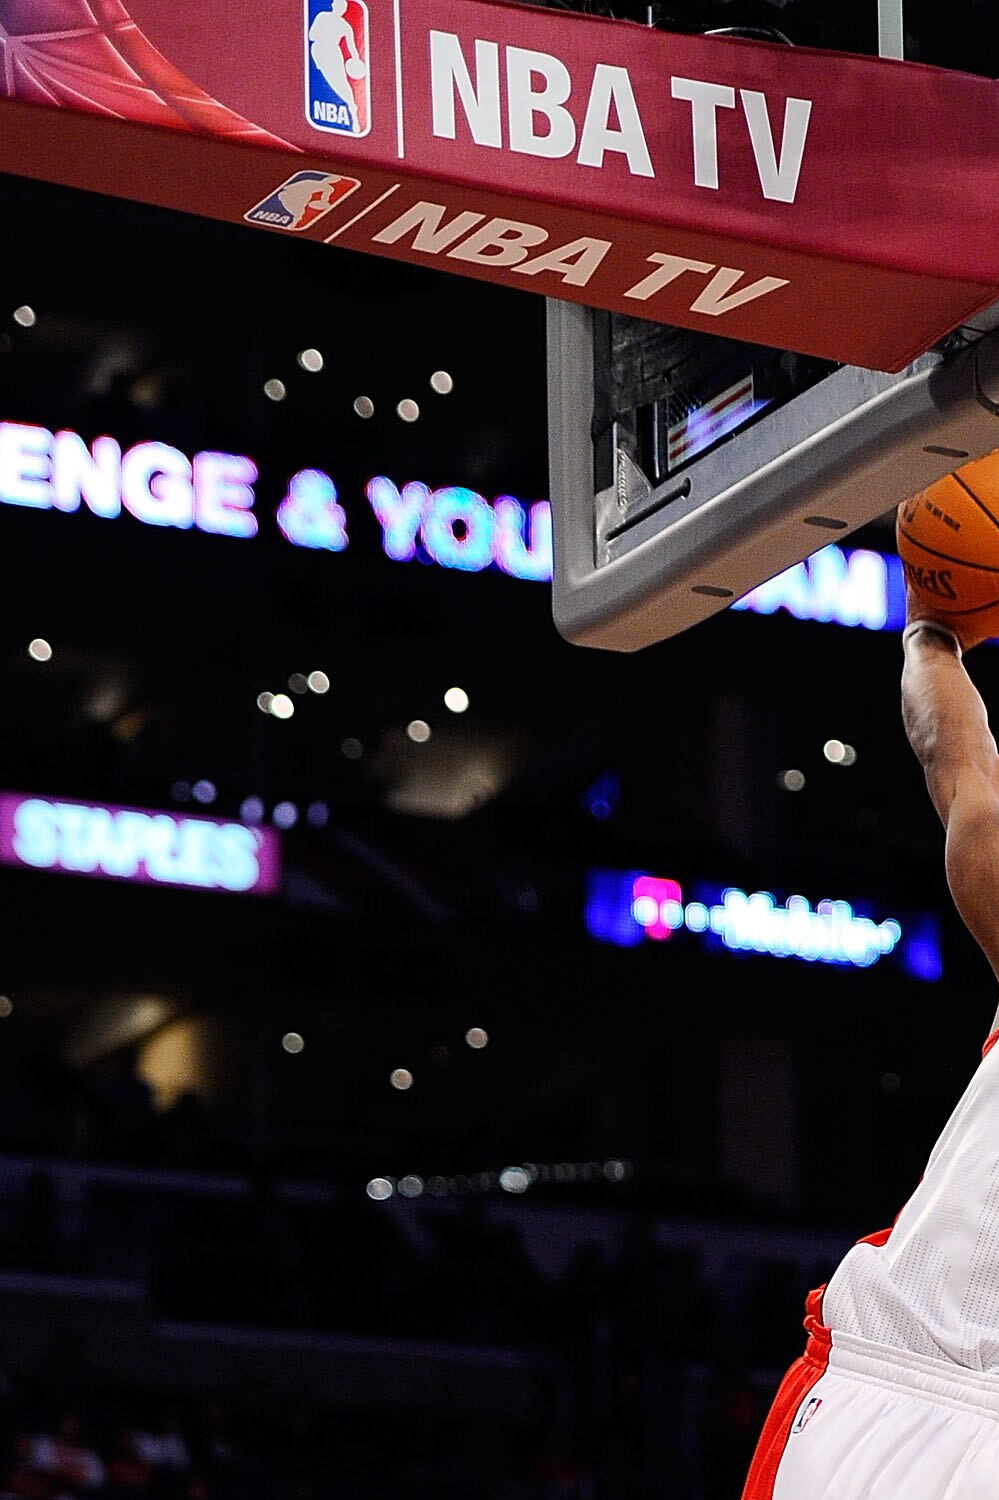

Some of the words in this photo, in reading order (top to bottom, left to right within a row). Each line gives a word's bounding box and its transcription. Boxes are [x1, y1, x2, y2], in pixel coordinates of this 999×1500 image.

[313, 100, 351, 126] NBA
[429, 29, 656, 178] NBA
[670, 75, 813, 204] TV
[252, 210, 294, 225] NBA
[373, 201, 613, 287] NBA
[622, 251, 791, 317] TV
[276, 468, 349, 552] &
[12, 799, 261, 891] STAPLES
